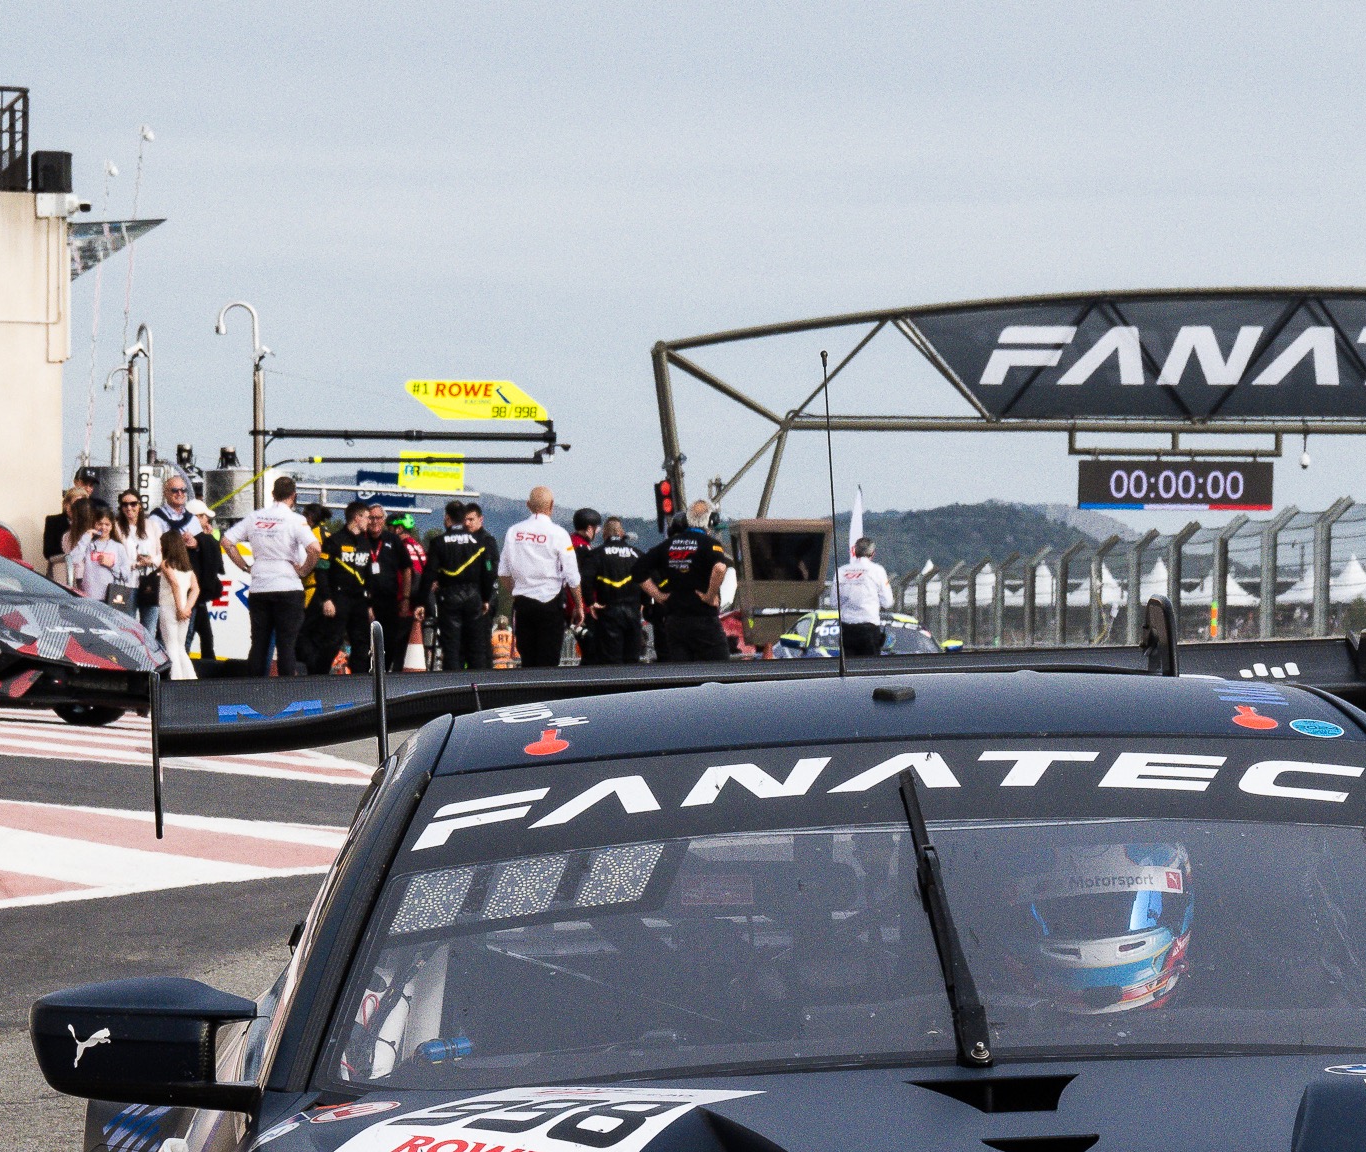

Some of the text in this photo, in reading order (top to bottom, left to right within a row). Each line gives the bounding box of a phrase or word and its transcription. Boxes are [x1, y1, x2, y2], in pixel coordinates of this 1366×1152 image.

[412, 382, 494, 397] #1 ROWE
[1109, 470, 1245, 500] 00:00:00
[515, 532, 547, 544] SRO
[411, 750, 1365, 851] FANATEC
